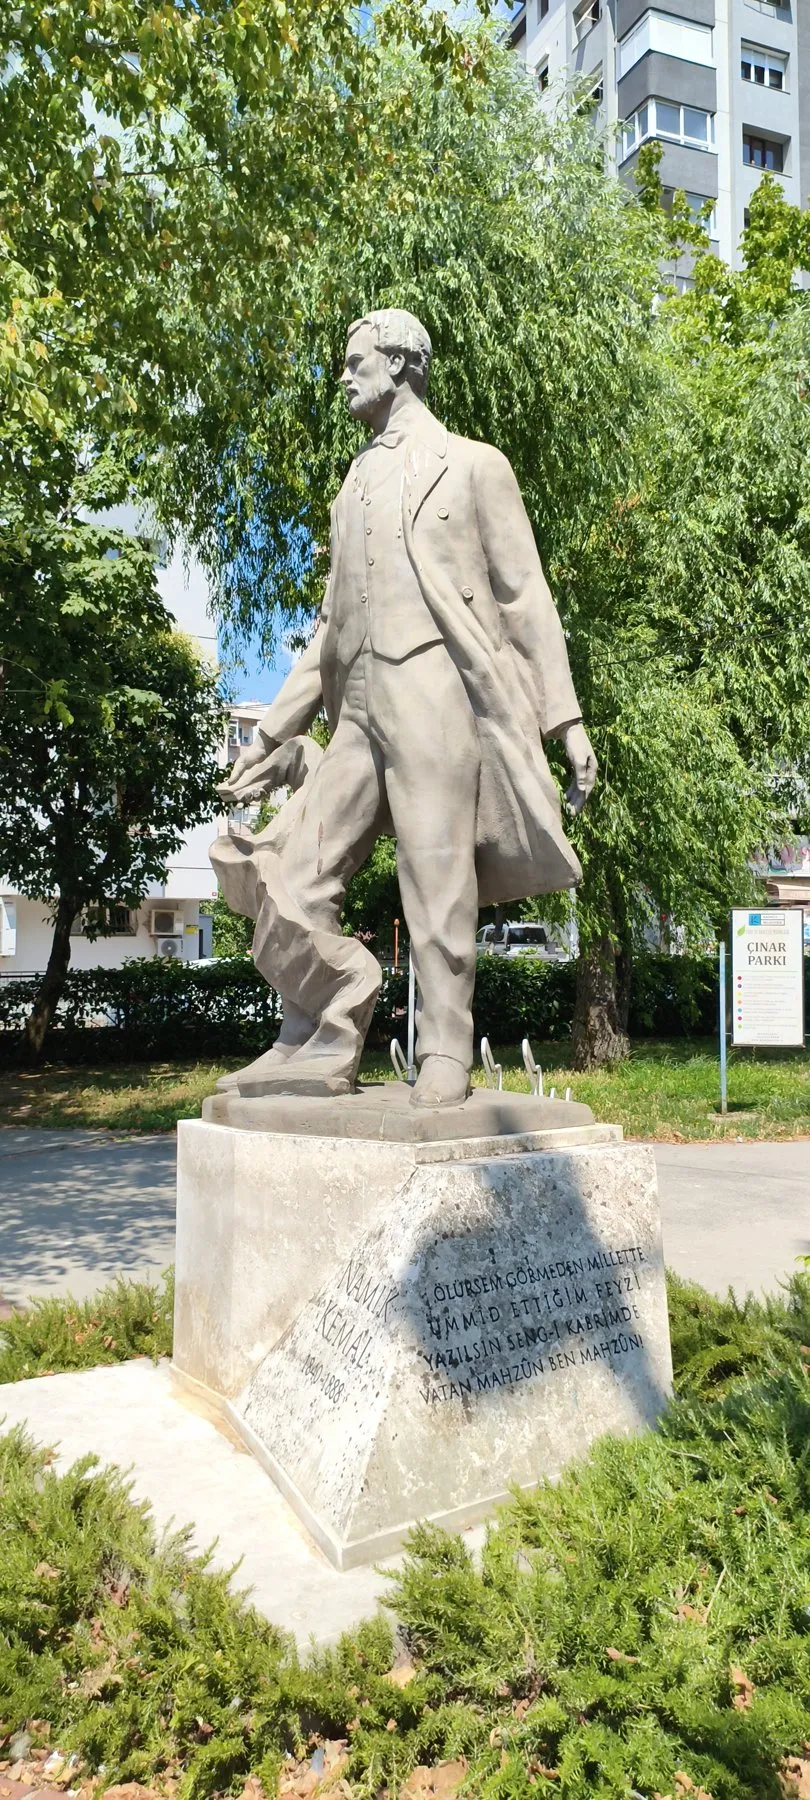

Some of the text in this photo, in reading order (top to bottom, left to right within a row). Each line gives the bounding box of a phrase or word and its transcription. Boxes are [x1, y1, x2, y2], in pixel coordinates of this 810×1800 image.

[747, 942, 787, 954] ÇINAR
[748, 956, 787, 966] PARKI
[337, 1259, 400, 1323] NAMIK
[434, 1274, 503, 1302] ÖLÜRSEM
[506, 1258, 584, 1287] GÖRMEDEN
[315, 1300, 372, 1369] KEMAL
[423, 1337, 502, 1371] YAZILSIN
[302, 1353, 345, 1404] 1840-1888
[419, 1332, 645, 1404] VATAN MAHZÛN BEN MAHZÛN!
